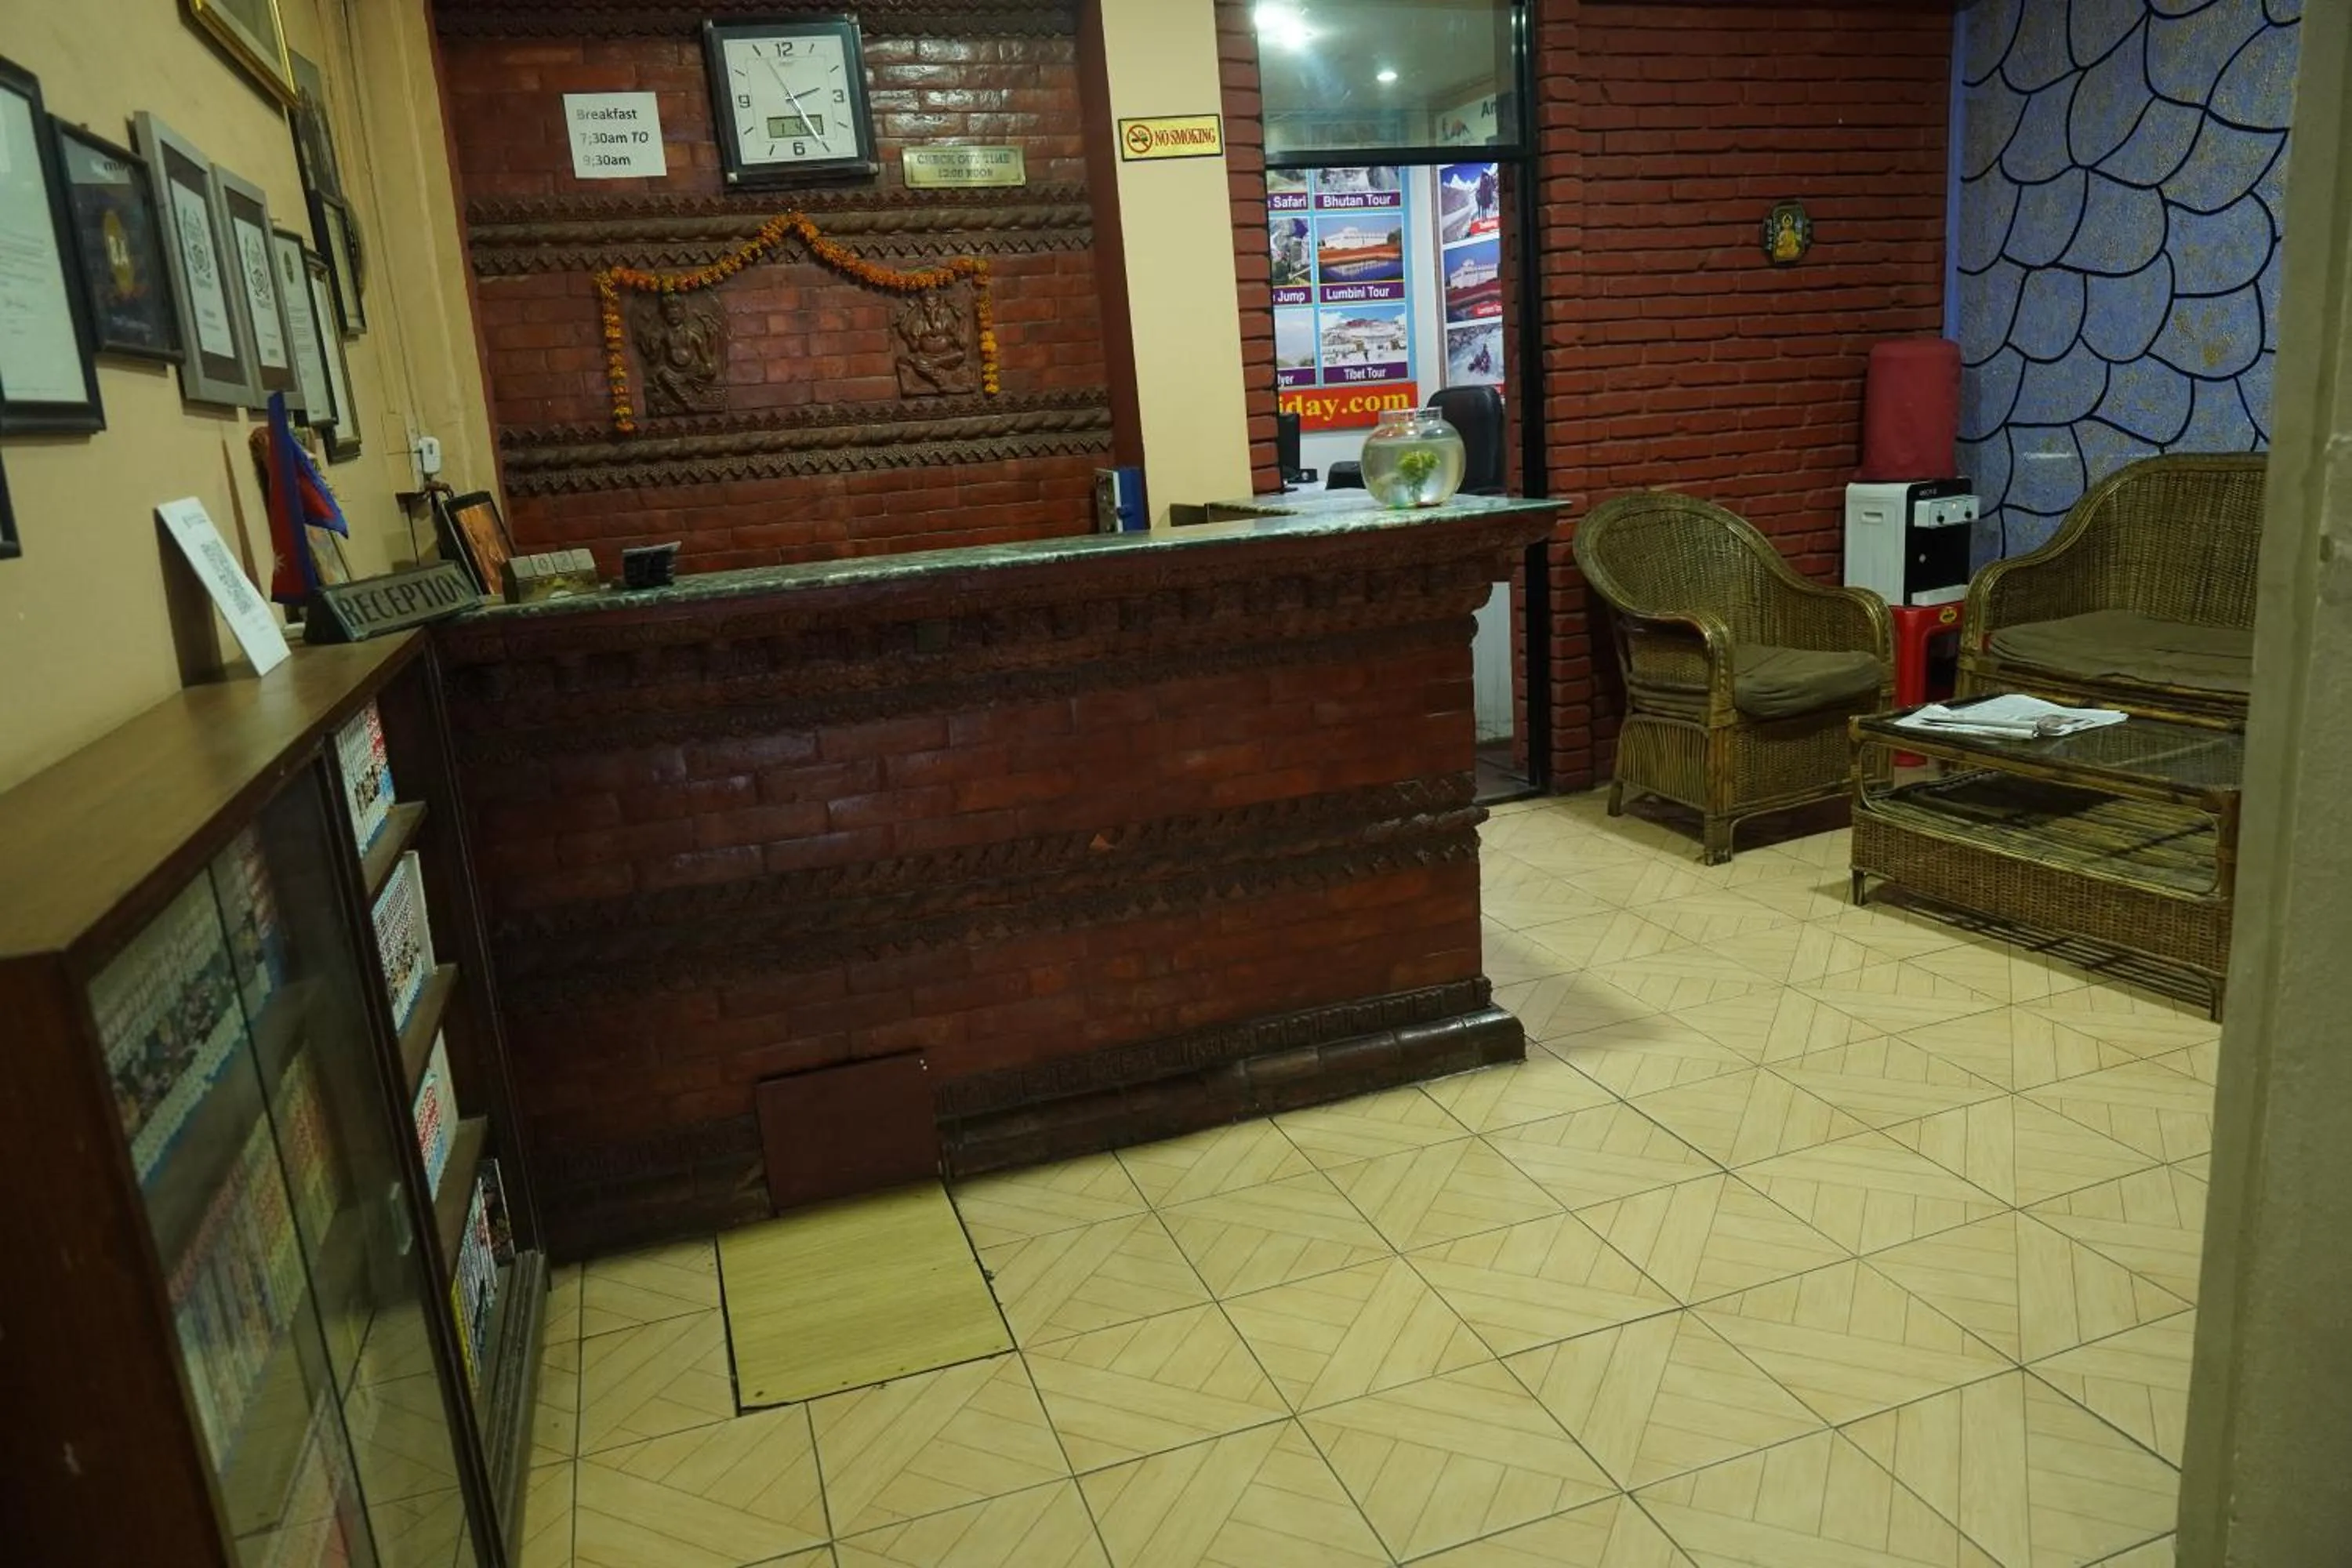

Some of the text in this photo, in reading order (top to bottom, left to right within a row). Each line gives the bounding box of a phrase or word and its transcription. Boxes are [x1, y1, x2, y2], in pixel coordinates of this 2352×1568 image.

[775, 42, 793, 57] 12
[738, 94, 750, 108] 9
[832, 89, 845, 103] 3
[576, 107, 637, 120] Breakfast
[631, 131, 649, 143] TO
[1155, 128, 1216, 147] NO SMOKING
[793, 142, 805, 156] 6
[916, 154, 955, 165] CHECK
[985, 152, 1011, 164] TIME
[1274, 195, 1307, 208] Safari
[1323, 194, 1392, 208] Bhutan Tour
[1277, 291, 1305, 304] Jump
[1326, 285, 1390, 300] Lumbini Tour
[1277, 373, 1294, 386] lyer
[1344, 367, 1386, 380] Tibet Tour
[1279, 393, 1409, 421] iday.com
[337, 574, 466, 626] RECEPTION
